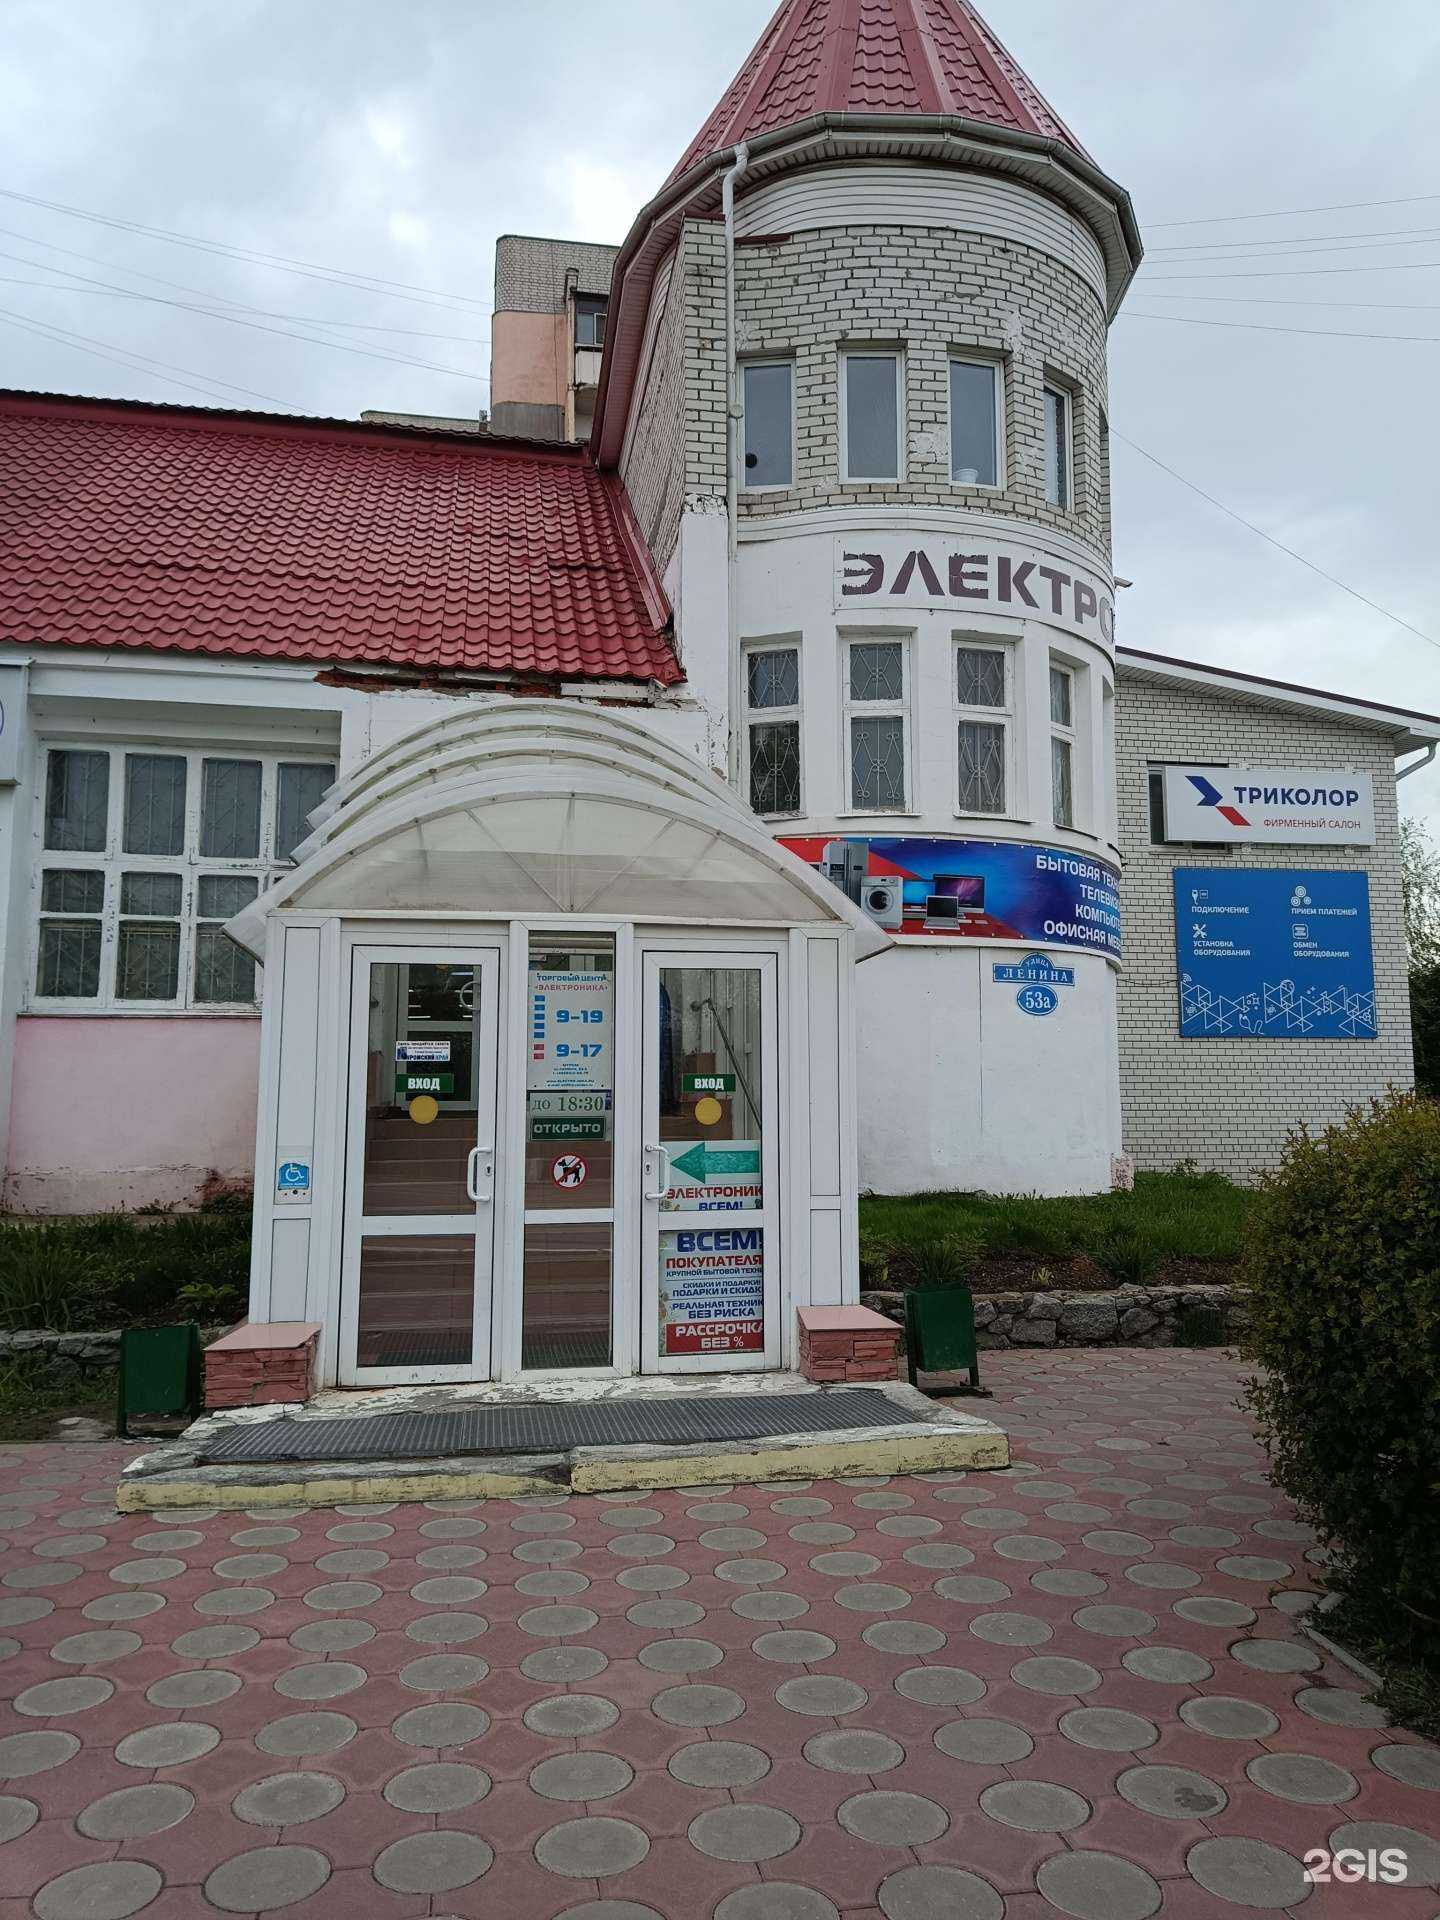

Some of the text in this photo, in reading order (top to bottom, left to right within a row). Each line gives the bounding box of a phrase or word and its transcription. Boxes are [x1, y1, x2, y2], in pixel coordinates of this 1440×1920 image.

[1233, 786, 1359, 807] ТРИКОЛОР
[1263, 818, 1361, 829] ФИРМЕННЫЙ САЛОН
[1036, 855, 1100, 882] БЫТОВАЯ
[1191, 906, 1250, 914] ПОДКЛЮЧЕНИЕ
[1291, 908, 1358, 917] ПРИЕМ ПЛАТЕЖЕЙ
[1043, 920, 1106, 945] ОФИСНАЯ
[1193, 940, 1234, 948] УСТАНОВКА
[1293, 941, 1318, 949] ОБМЕН
[1193, 949, 1251, 957] ОБОРУДОВАНИЯ
[1293, 950, 1350, 959] ОБОРУДОВАНИЯ
[1003, 968, 1069, 982] ЛЕНИНА
[1025, 991, 1051, 1010] 53а
[556, 1009, 603, 1023] 9-19
[556, 1043, 603, 1058] 9-17
[407, 1077, 441, 1091] ВХОД
[694, 1078, 725, 1091] ВХОД
[558, 1096, 604, 1112] 18:30
[533, 1123, 601, 1134] ОТКРЫТО
[703, 1268, 740, 1276] БЫТОВОЙ
[672, 1288, 719, 1297] ПОДАРКИ
[672, 1301, 725, 1311] РЕАЛЬНАЯ
[689, 1308, 755, 1319] БЕЗ РИСКА
[701, 1336, 744, 1349] БЕЗ %
